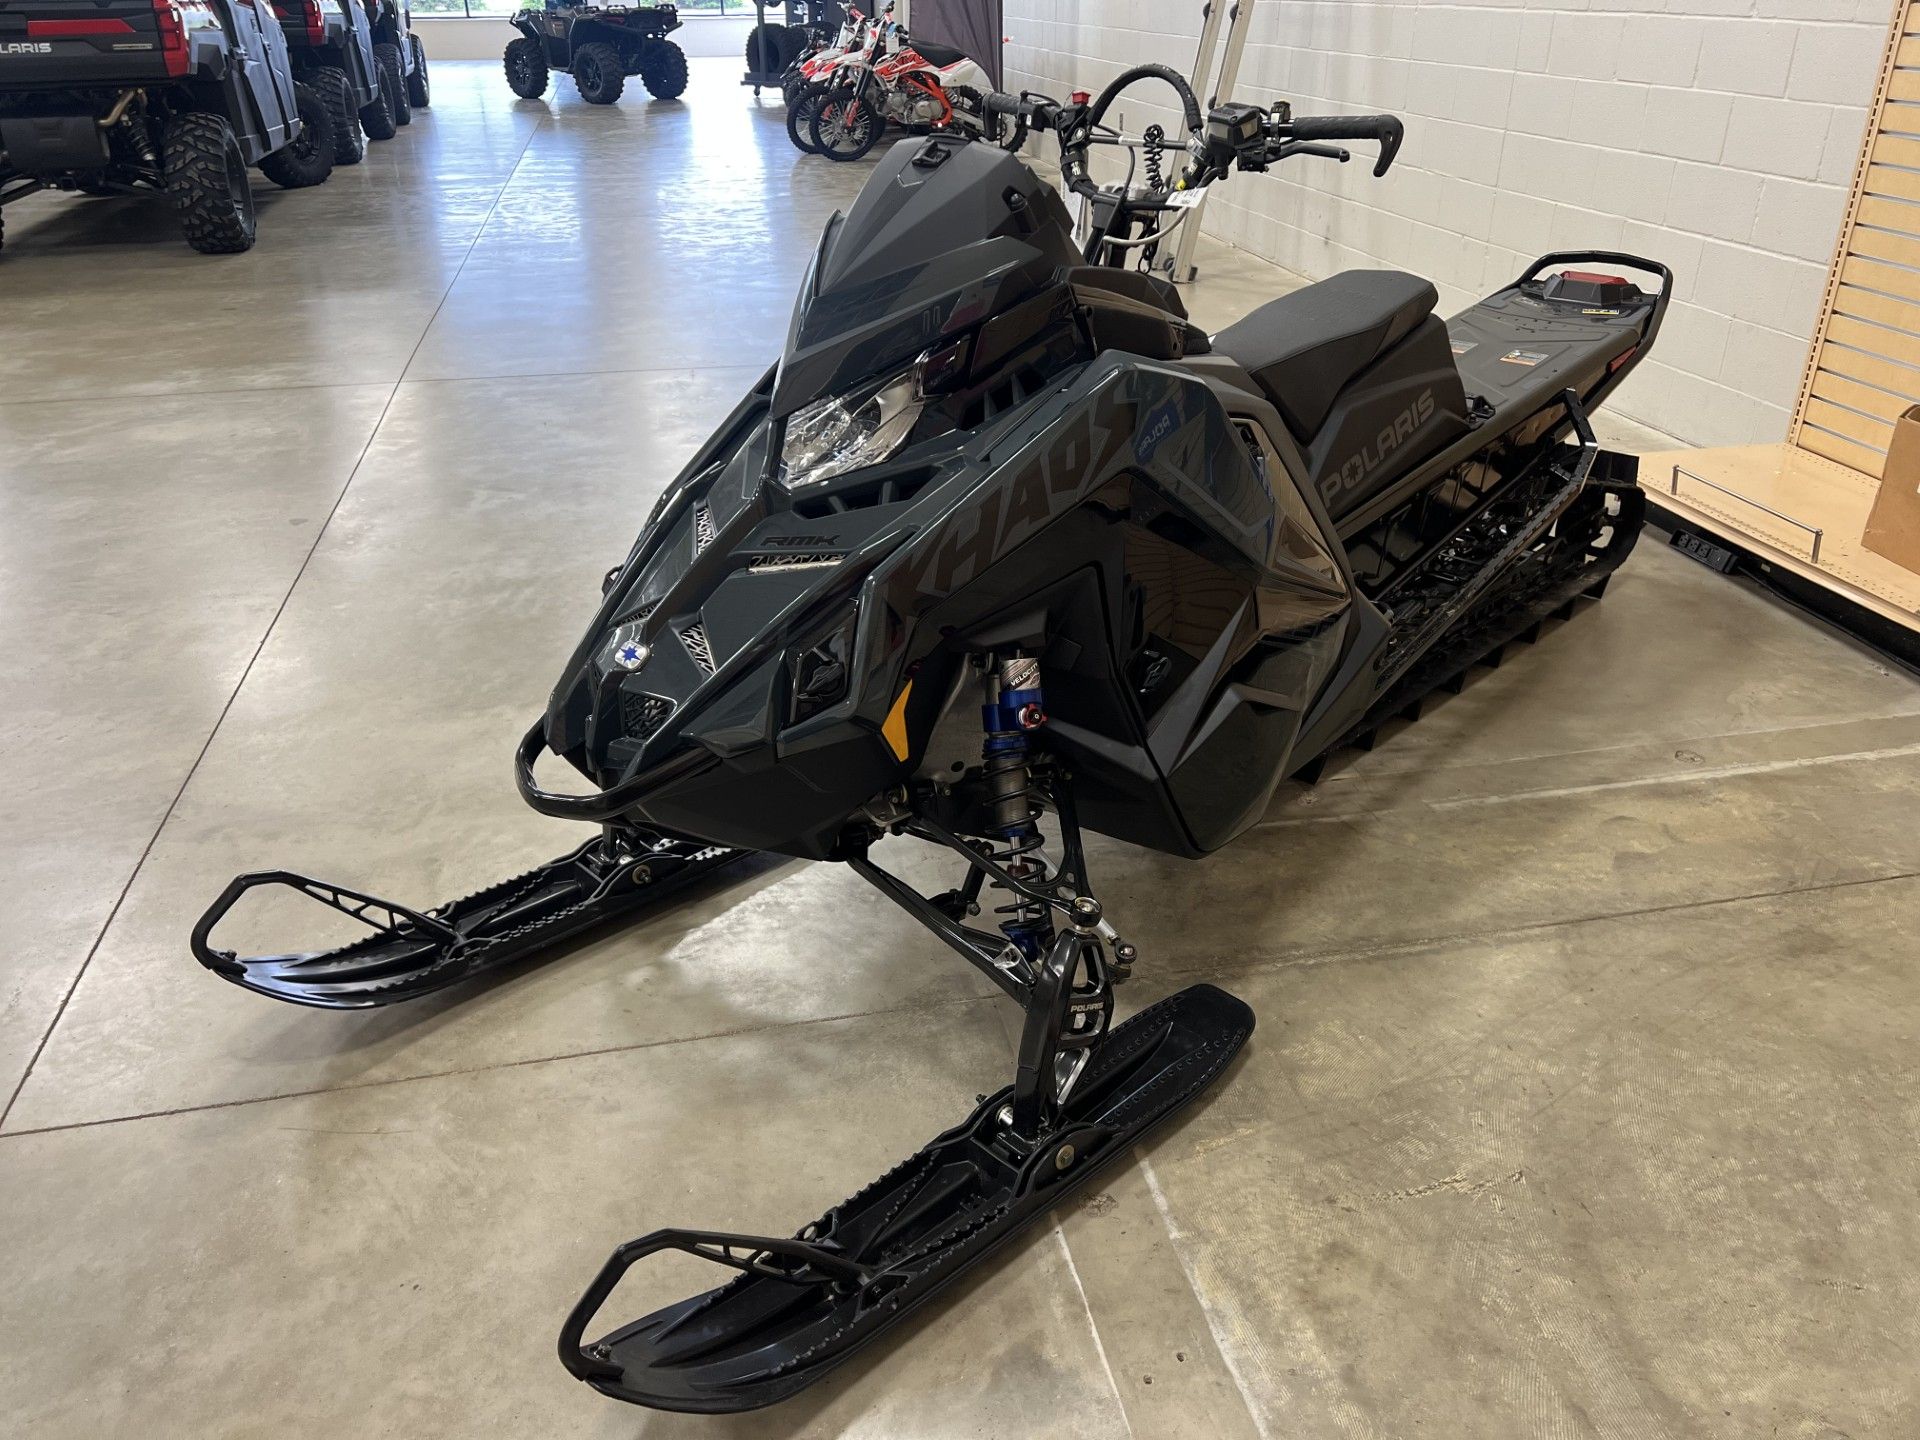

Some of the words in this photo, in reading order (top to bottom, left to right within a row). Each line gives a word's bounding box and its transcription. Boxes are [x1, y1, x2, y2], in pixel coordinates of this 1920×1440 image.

[0, 43, 52, 54] LARIS
[1319, 387, 1435, 508] POLARIS
[760, 534, 841, 547] RMK
[1070, 1001, 1105, 1013] POLARIS
